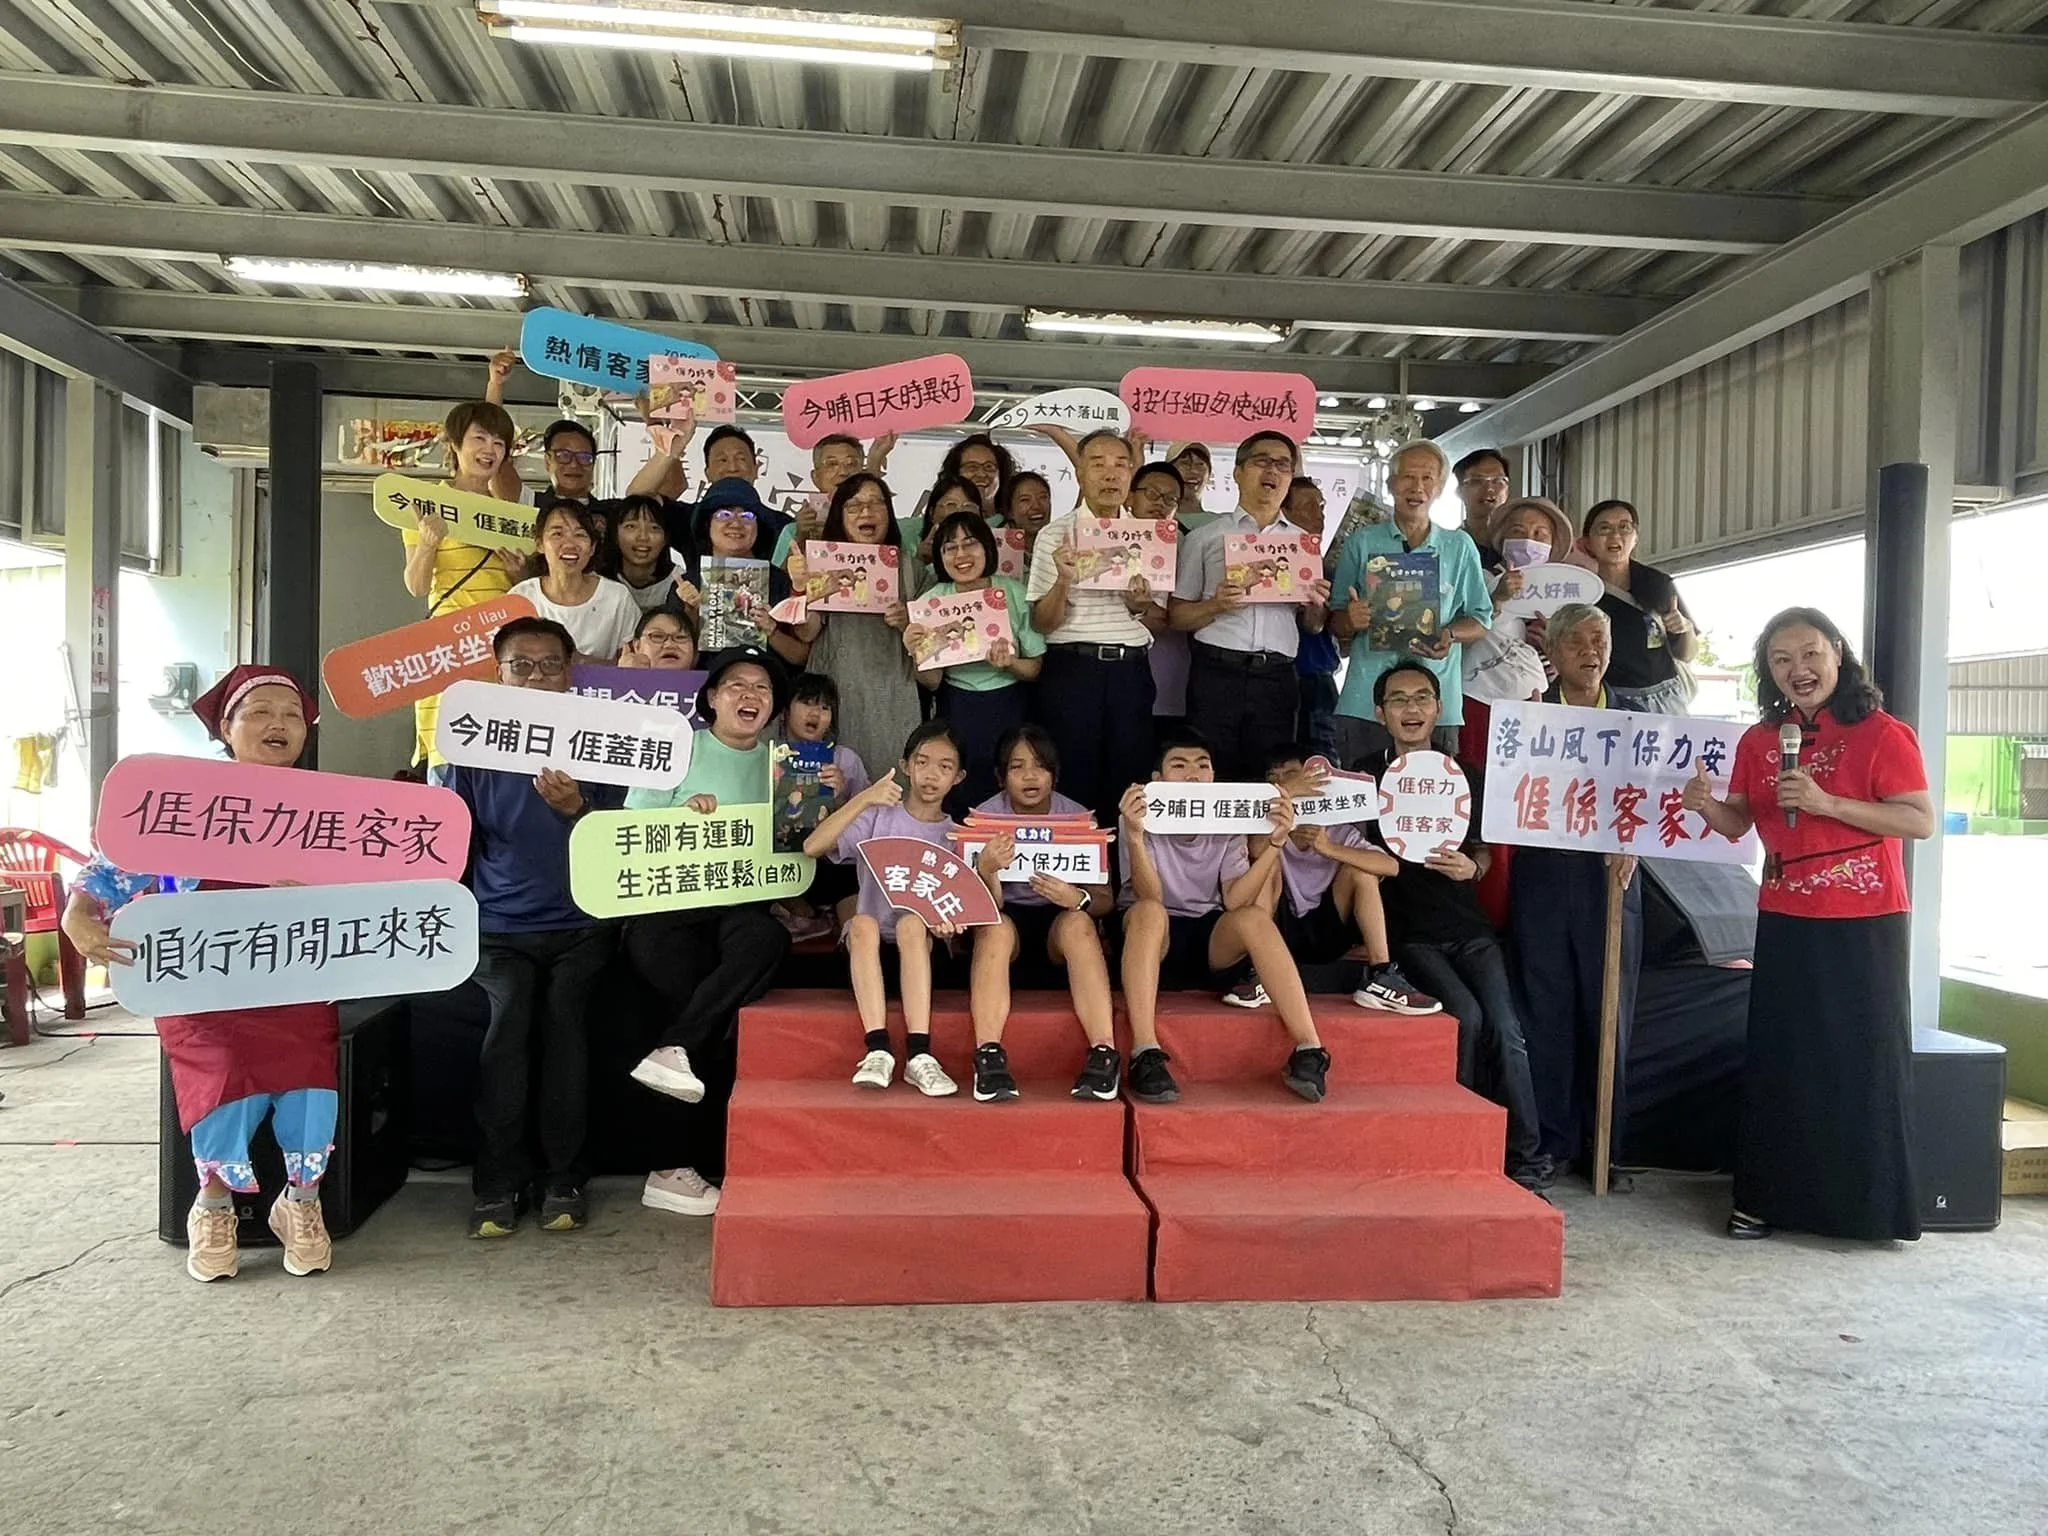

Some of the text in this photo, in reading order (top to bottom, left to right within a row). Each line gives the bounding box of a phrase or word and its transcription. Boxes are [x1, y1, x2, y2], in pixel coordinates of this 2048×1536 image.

[479, 608, 507, 626] liau
[361, 626, 501, 698] 歡迎來坐
[449, 713, 555, 757] 今晡日
[1495, 717, 1727, 776] 落山風下保力安
[1148, 799, 1205, 819] 今晡日
[615, 818, 754, 856] 手腳有運動
[884, 864, 964, 924] 客家庄
[1366, 982, 1409, 1006] FILA
